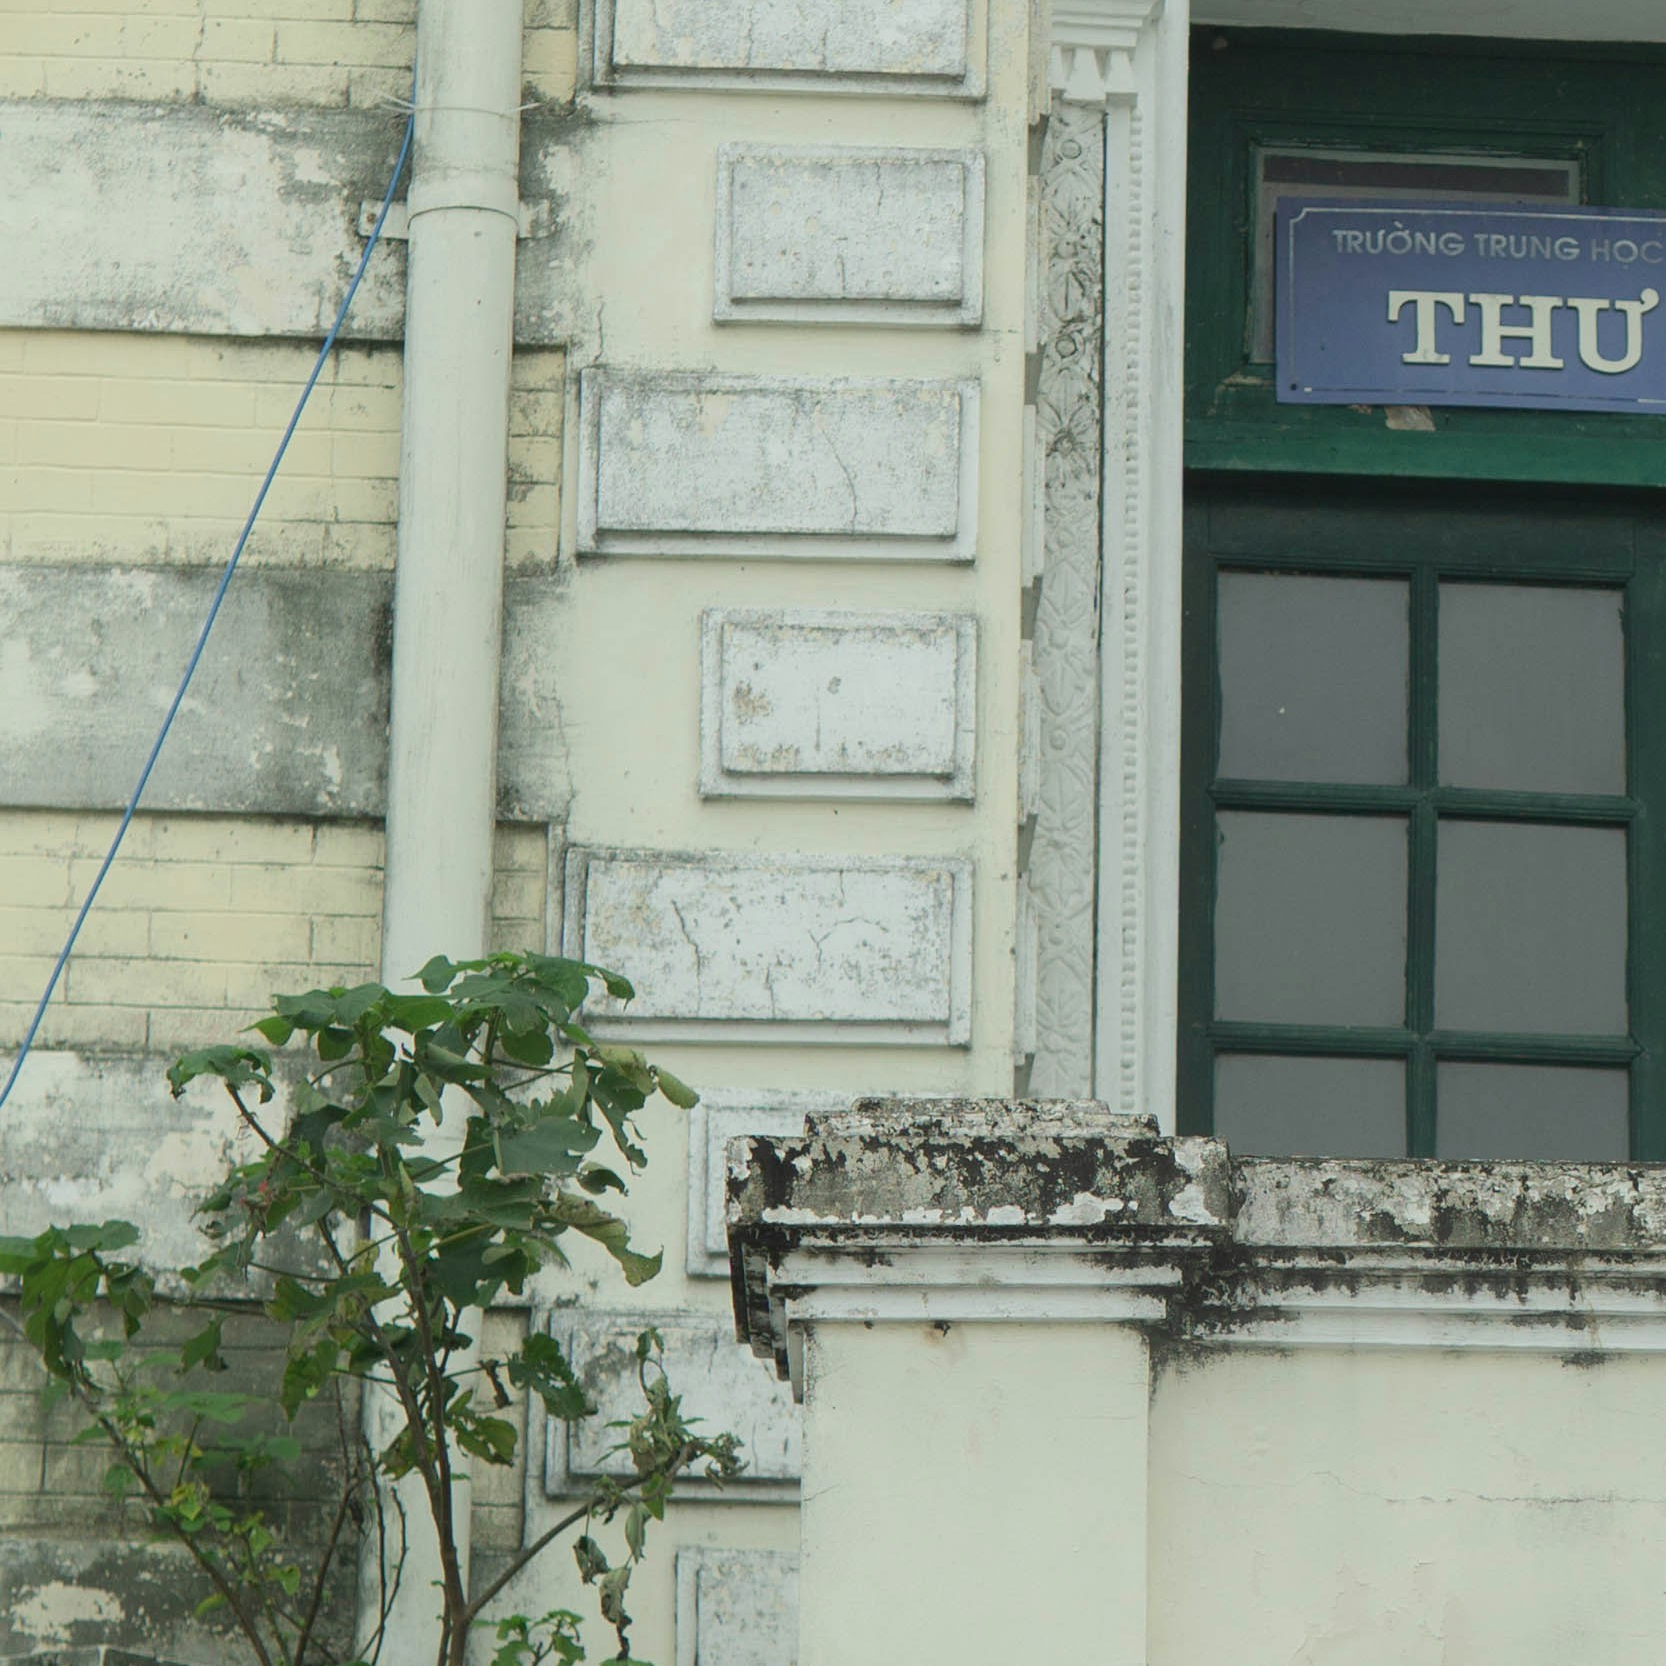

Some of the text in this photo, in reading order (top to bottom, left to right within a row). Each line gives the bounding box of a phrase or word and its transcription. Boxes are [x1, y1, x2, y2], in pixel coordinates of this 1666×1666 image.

[1332, 221, 1466, 256] TRƯỜNG
[1474, 232, 1581, 261] TRUNG
[1591, 239, 1664, 270] HỌC
[1387, 286, 1659, 375] THƯ
